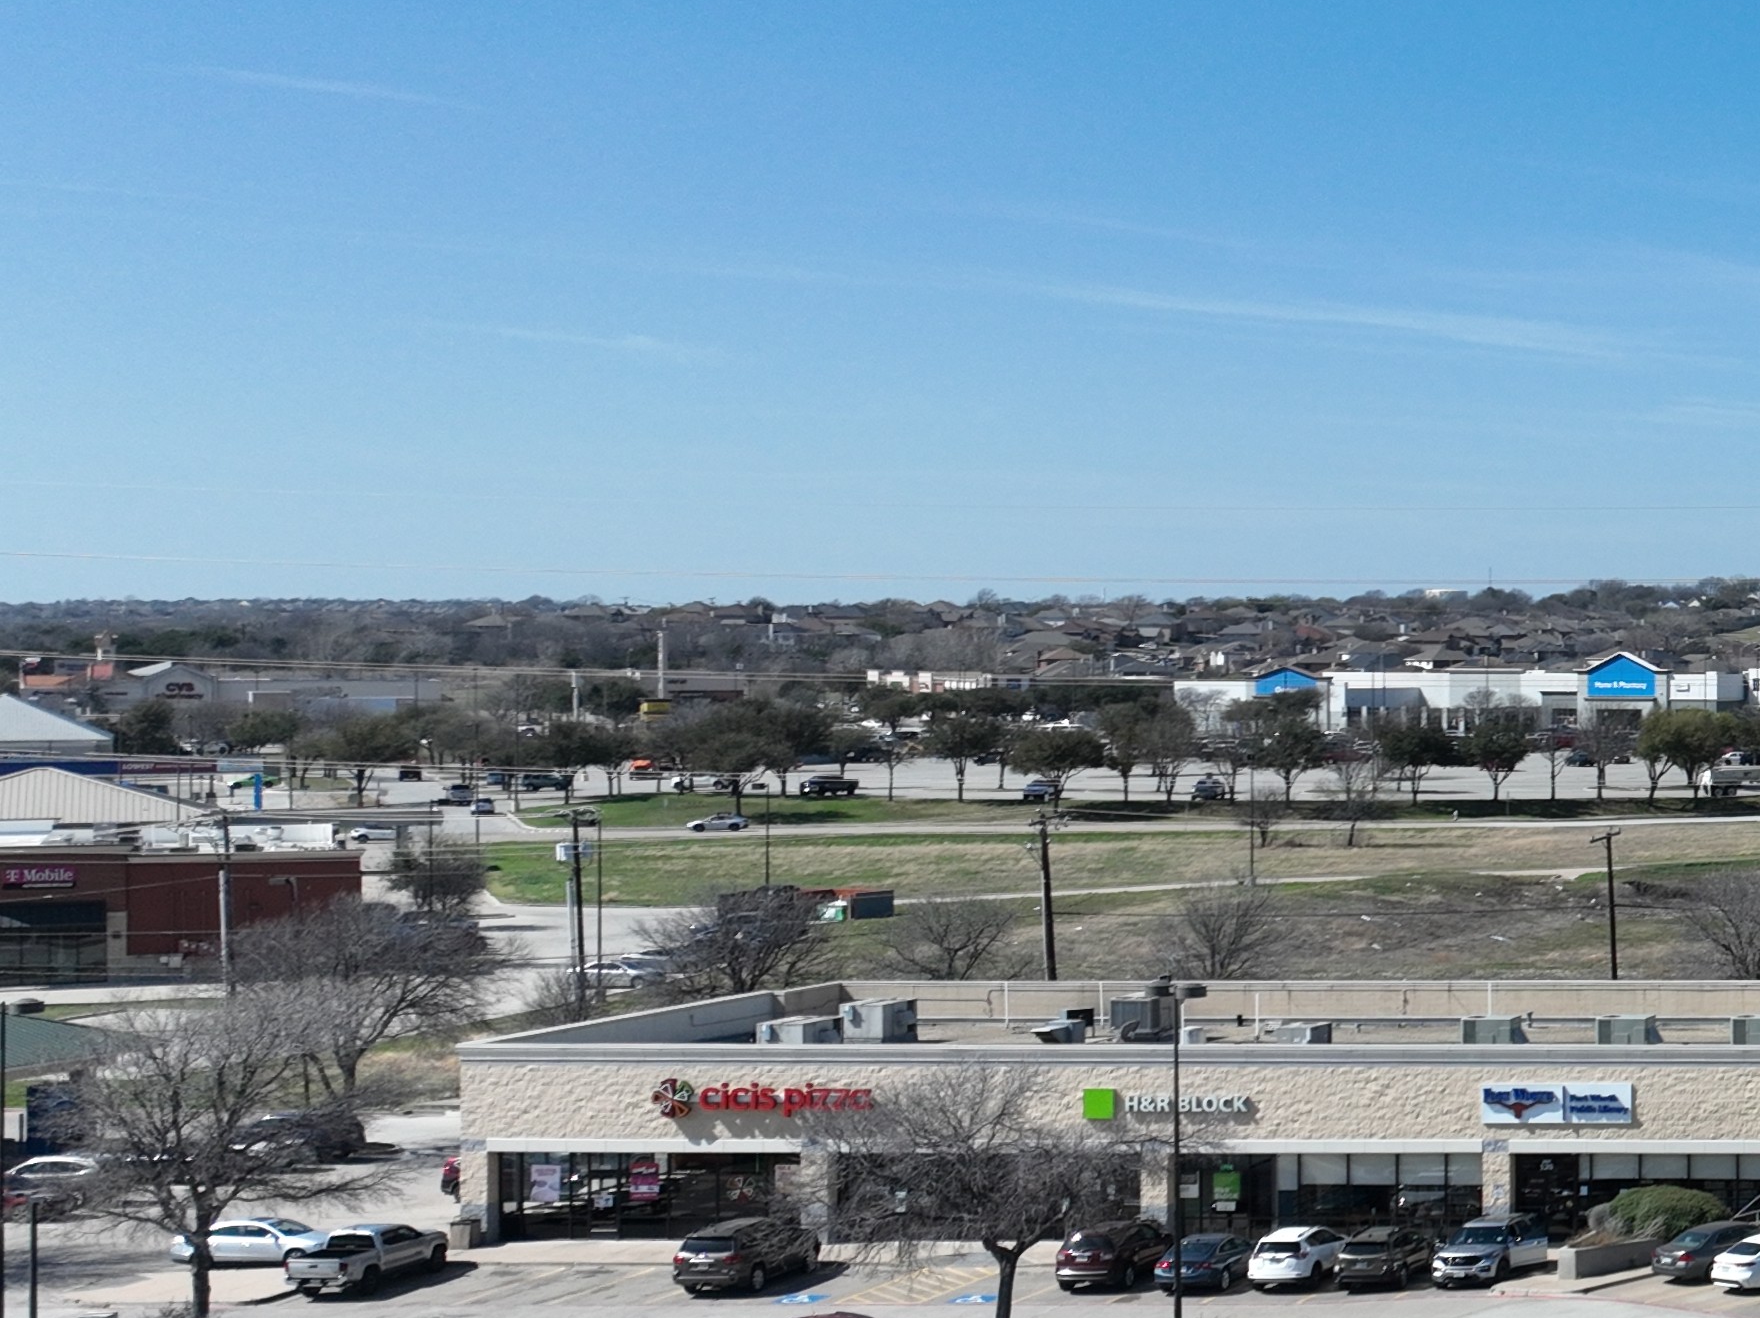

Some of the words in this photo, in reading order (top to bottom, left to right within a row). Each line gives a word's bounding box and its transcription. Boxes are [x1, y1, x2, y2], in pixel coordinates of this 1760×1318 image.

[166, 682, 195, 692] CVS
[22, 868, 74, 881] Mobile
[699, 1082, 778, 1111] cicis
[782, 1082, 873, 1118] pizza
[1124, 1096, 1170, 1113] H&R
[1178, 1096, 1248, 1113] BLOCK
